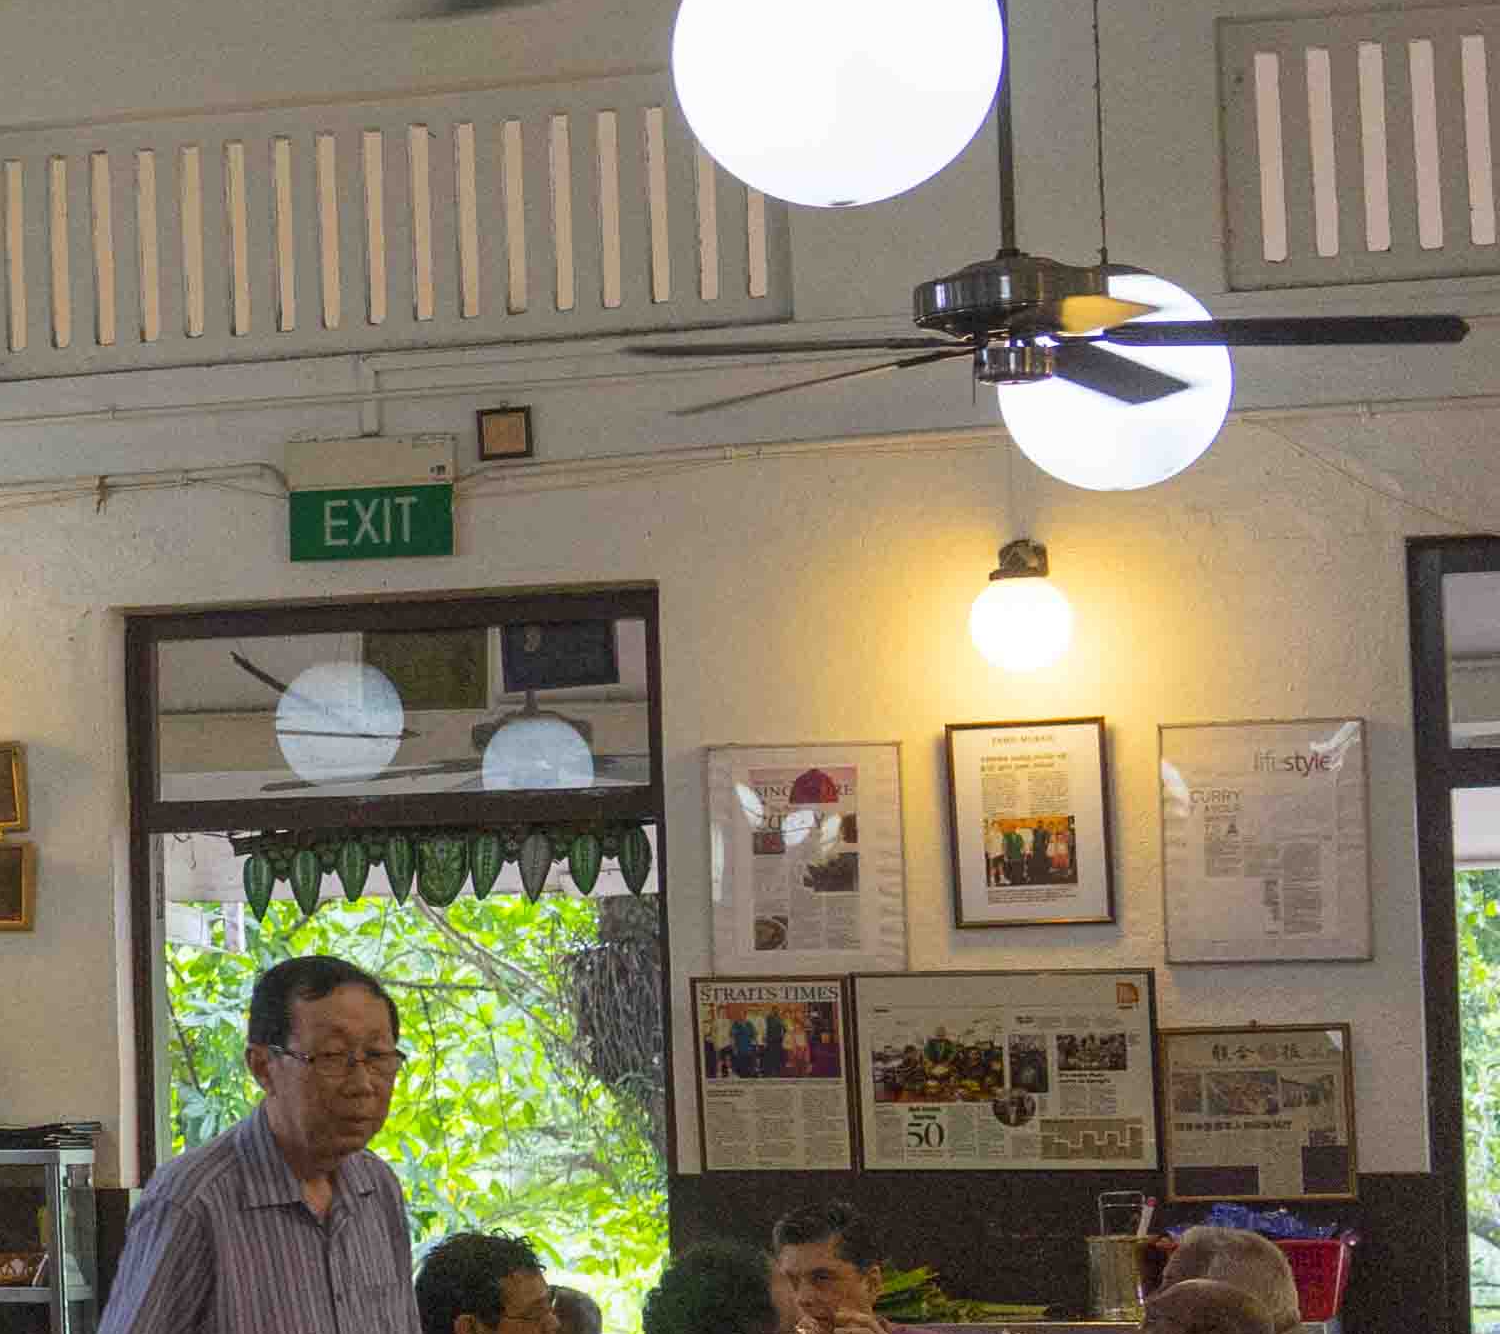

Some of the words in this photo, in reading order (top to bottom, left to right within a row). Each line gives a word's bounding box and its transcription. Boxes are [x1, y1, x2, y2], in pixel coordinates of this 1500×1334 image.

[323, 496, 418, 546] EXIT
[700, 986, 777, 1001] STRAITS
[781, 986, 839, 1001] TIMES
[907, 1122, 944, 1148] 50
